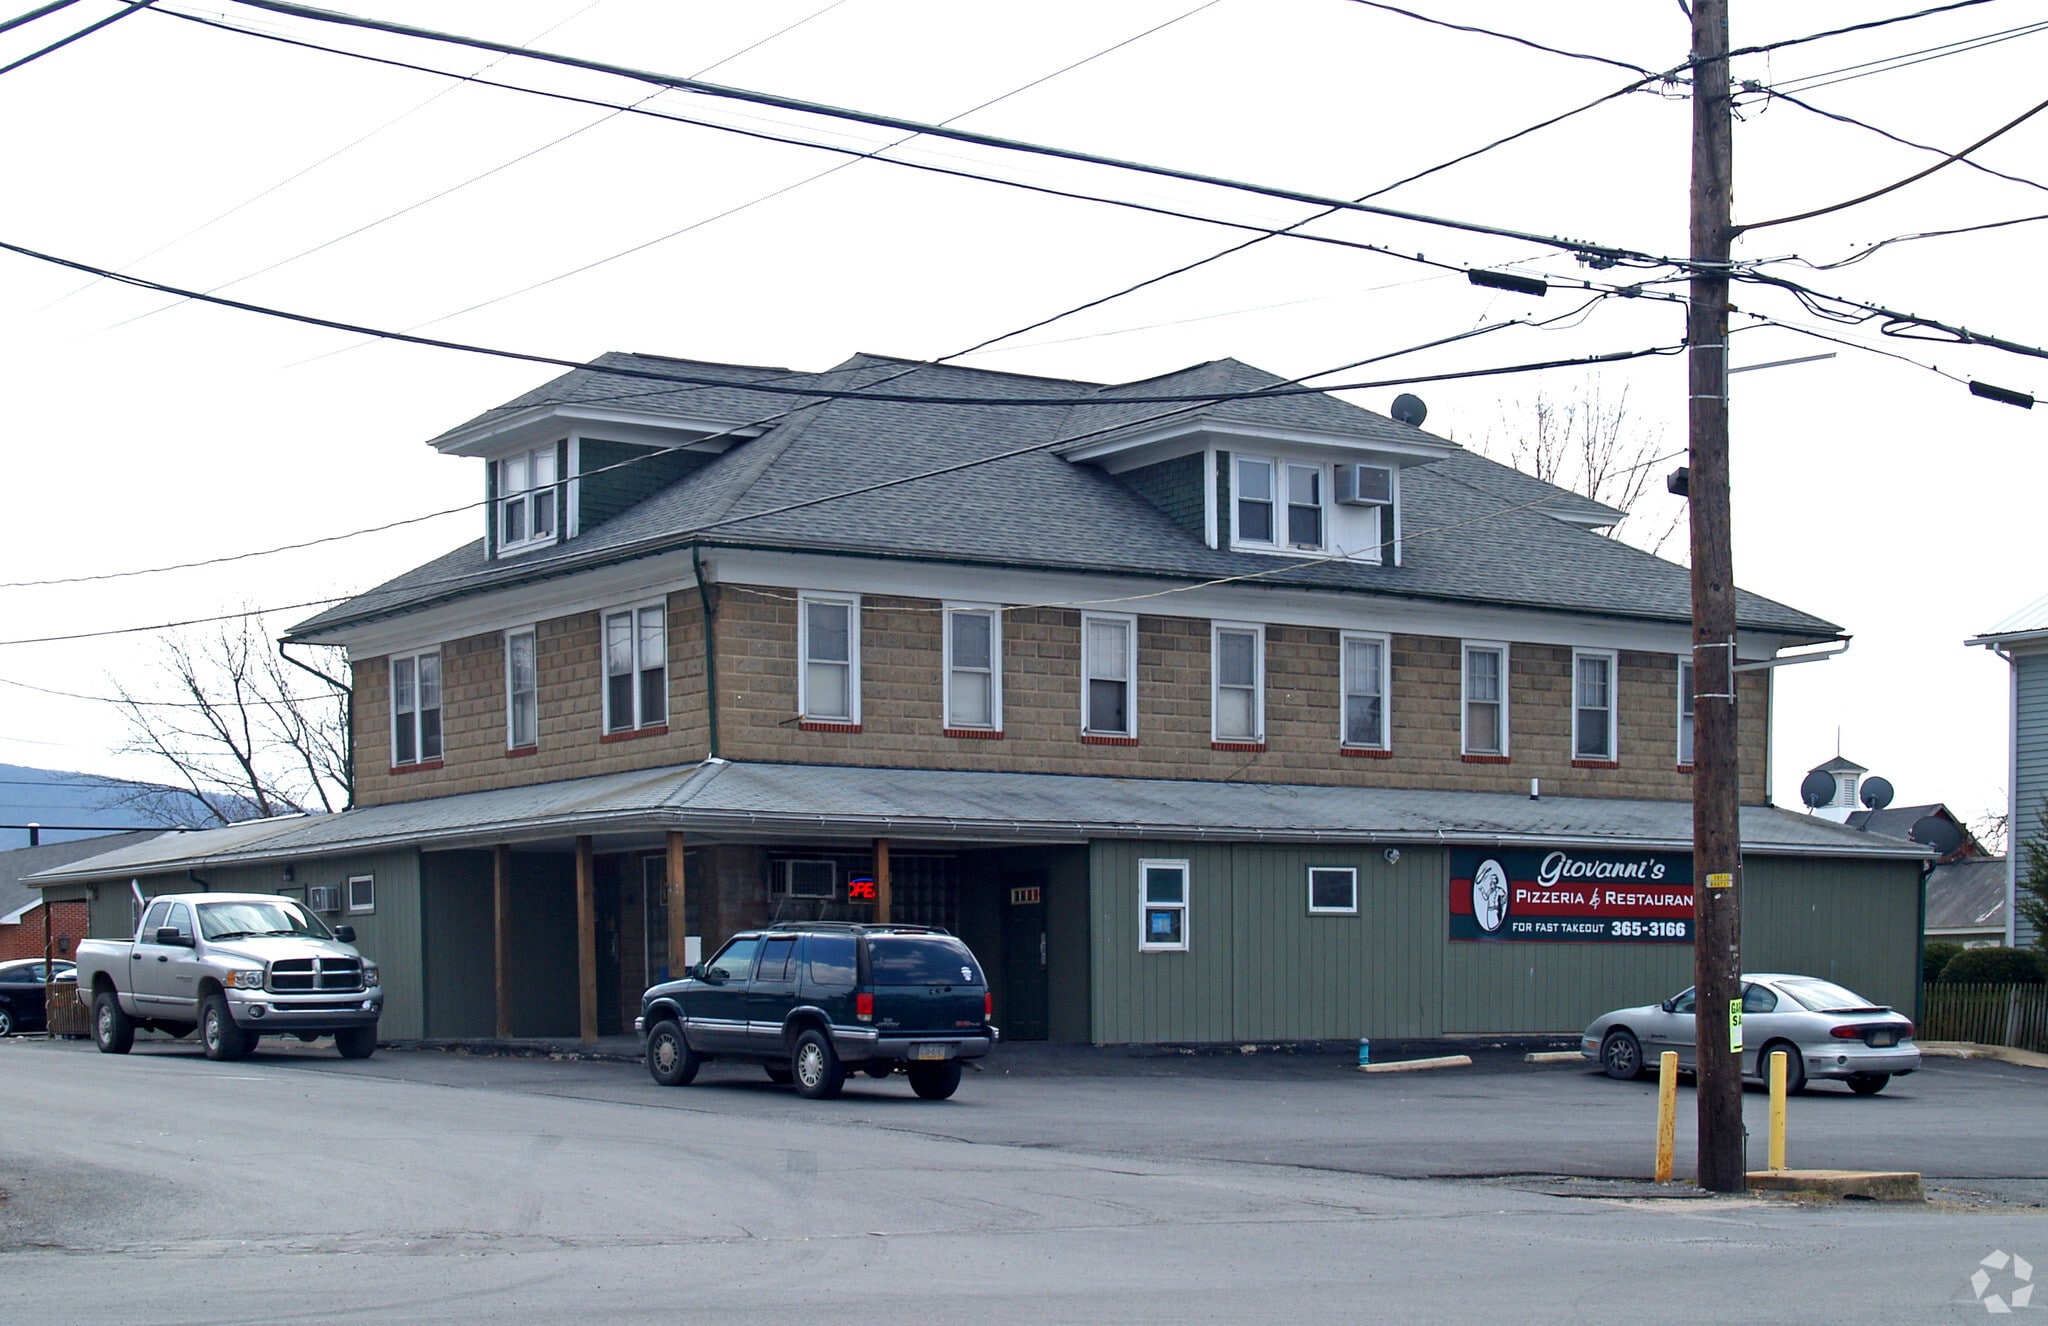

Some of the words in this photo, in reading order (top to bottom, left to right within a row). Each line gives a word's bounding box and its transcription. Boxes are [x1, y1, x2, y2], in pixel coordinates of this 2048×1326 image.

[1537, 851, 1665, 887] Giovanni's
[849, 881, 876, 899] OPE
[1605, 891, 1694, 906] RESTAURAN
[1512, 922, 1532, 932] FOR
[1536, 922, 1559, 932] FAST
[1561, 923, 1605, 933] TAKEOUT
[1611, 921, 1686, 937] 365-3166
